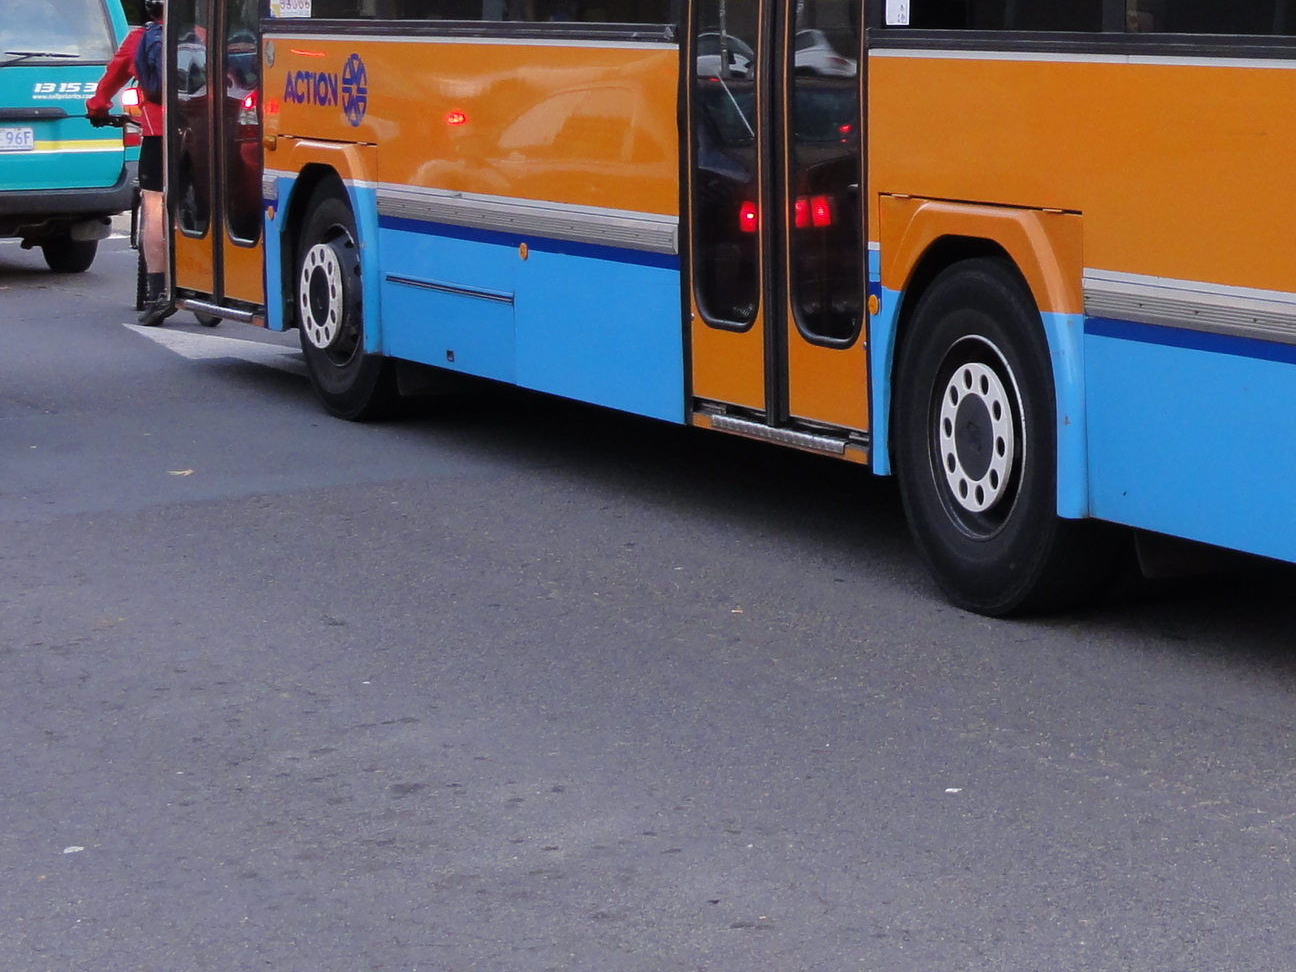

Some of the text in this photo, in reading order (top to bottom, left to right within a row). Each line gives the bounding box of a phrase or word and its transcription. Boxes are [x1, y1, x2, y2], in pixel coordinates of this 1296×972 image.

[34, 82, 57, 93] 13
[58, 82, 82, 93] 15
[283, 70, 338, 107] ACTION
